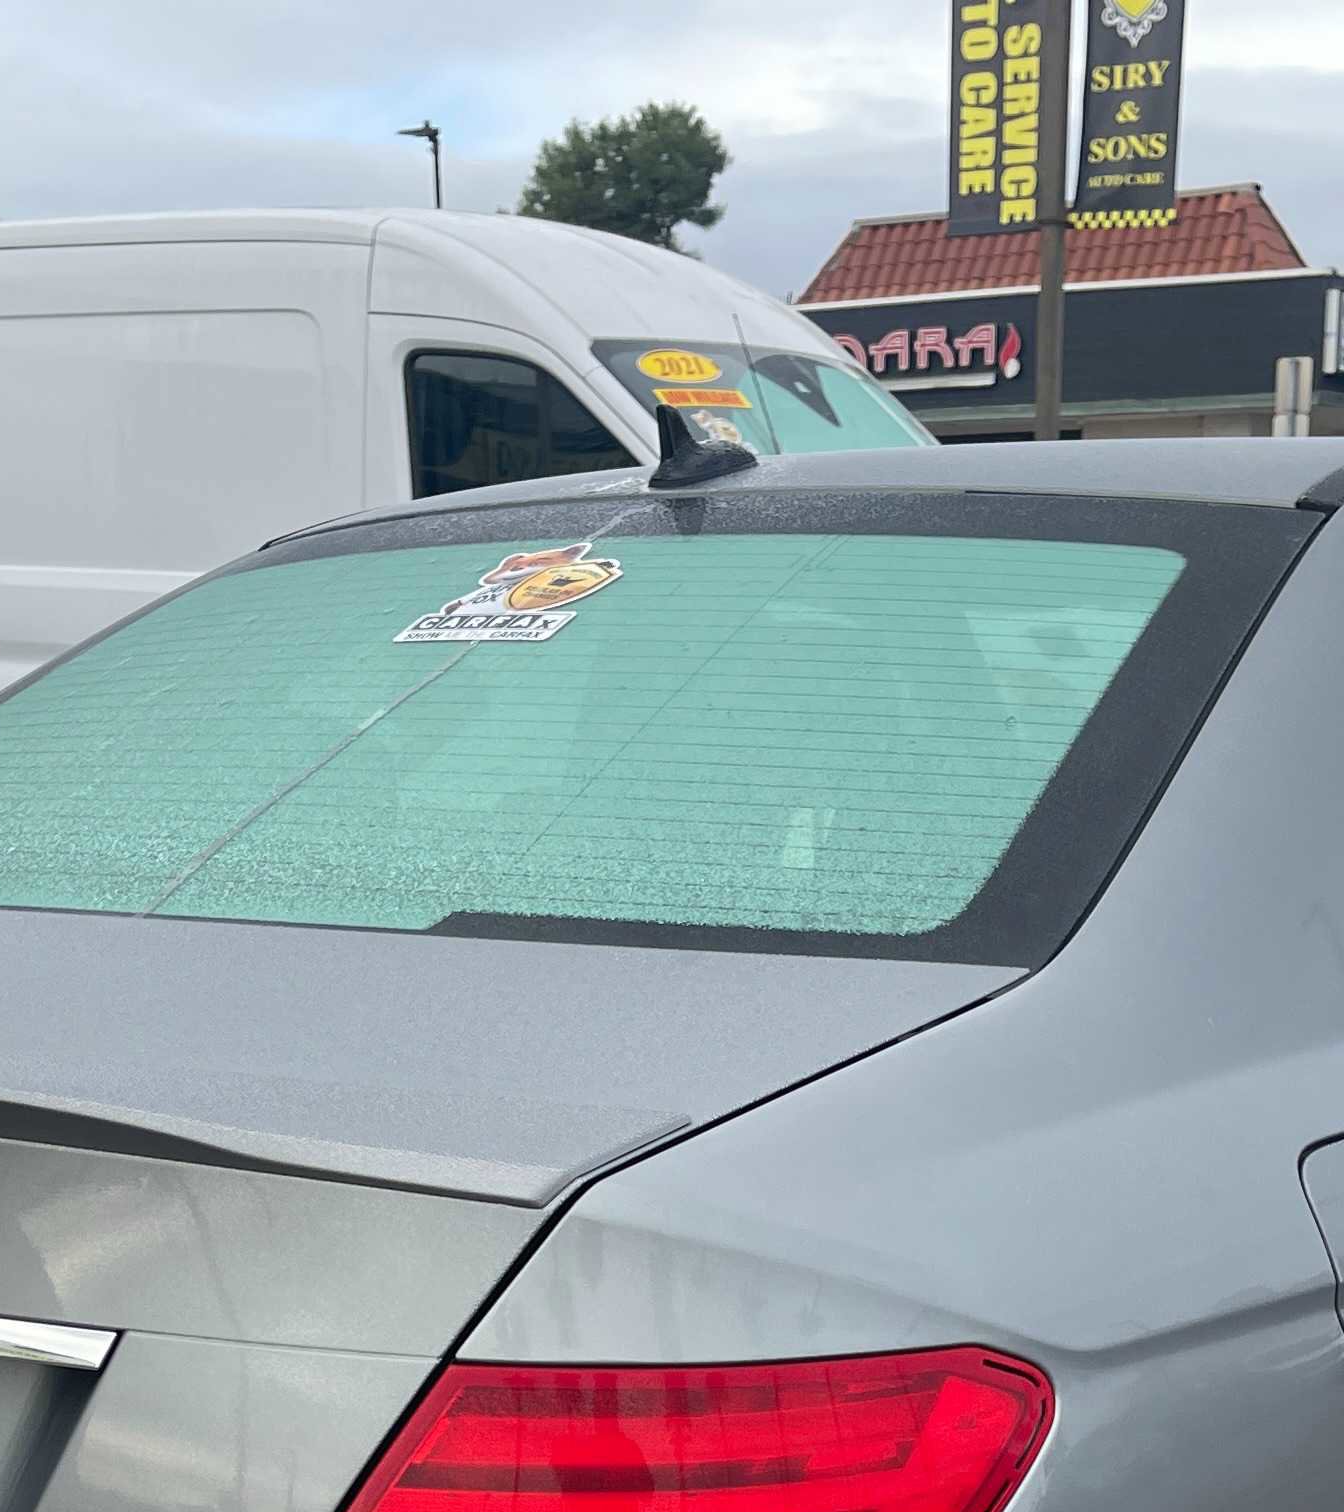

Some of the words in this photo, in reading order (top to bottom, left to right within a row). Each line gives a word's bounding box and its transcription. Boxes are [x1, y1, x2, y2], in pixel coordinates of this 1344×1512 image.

[1090, 60, 1170, 92] SIRY
[999, 22, 1042, 225] SERVICE
[1114, 100, 1141, 124] &
[958, 71, 998, 197] CARE
[1087, 132, 1168, 164] SONS
[654, 357, 704, 376] 2021
[418, 615, 556, 630] CARFAX
[489, 630, 546, 639] CARFAX
